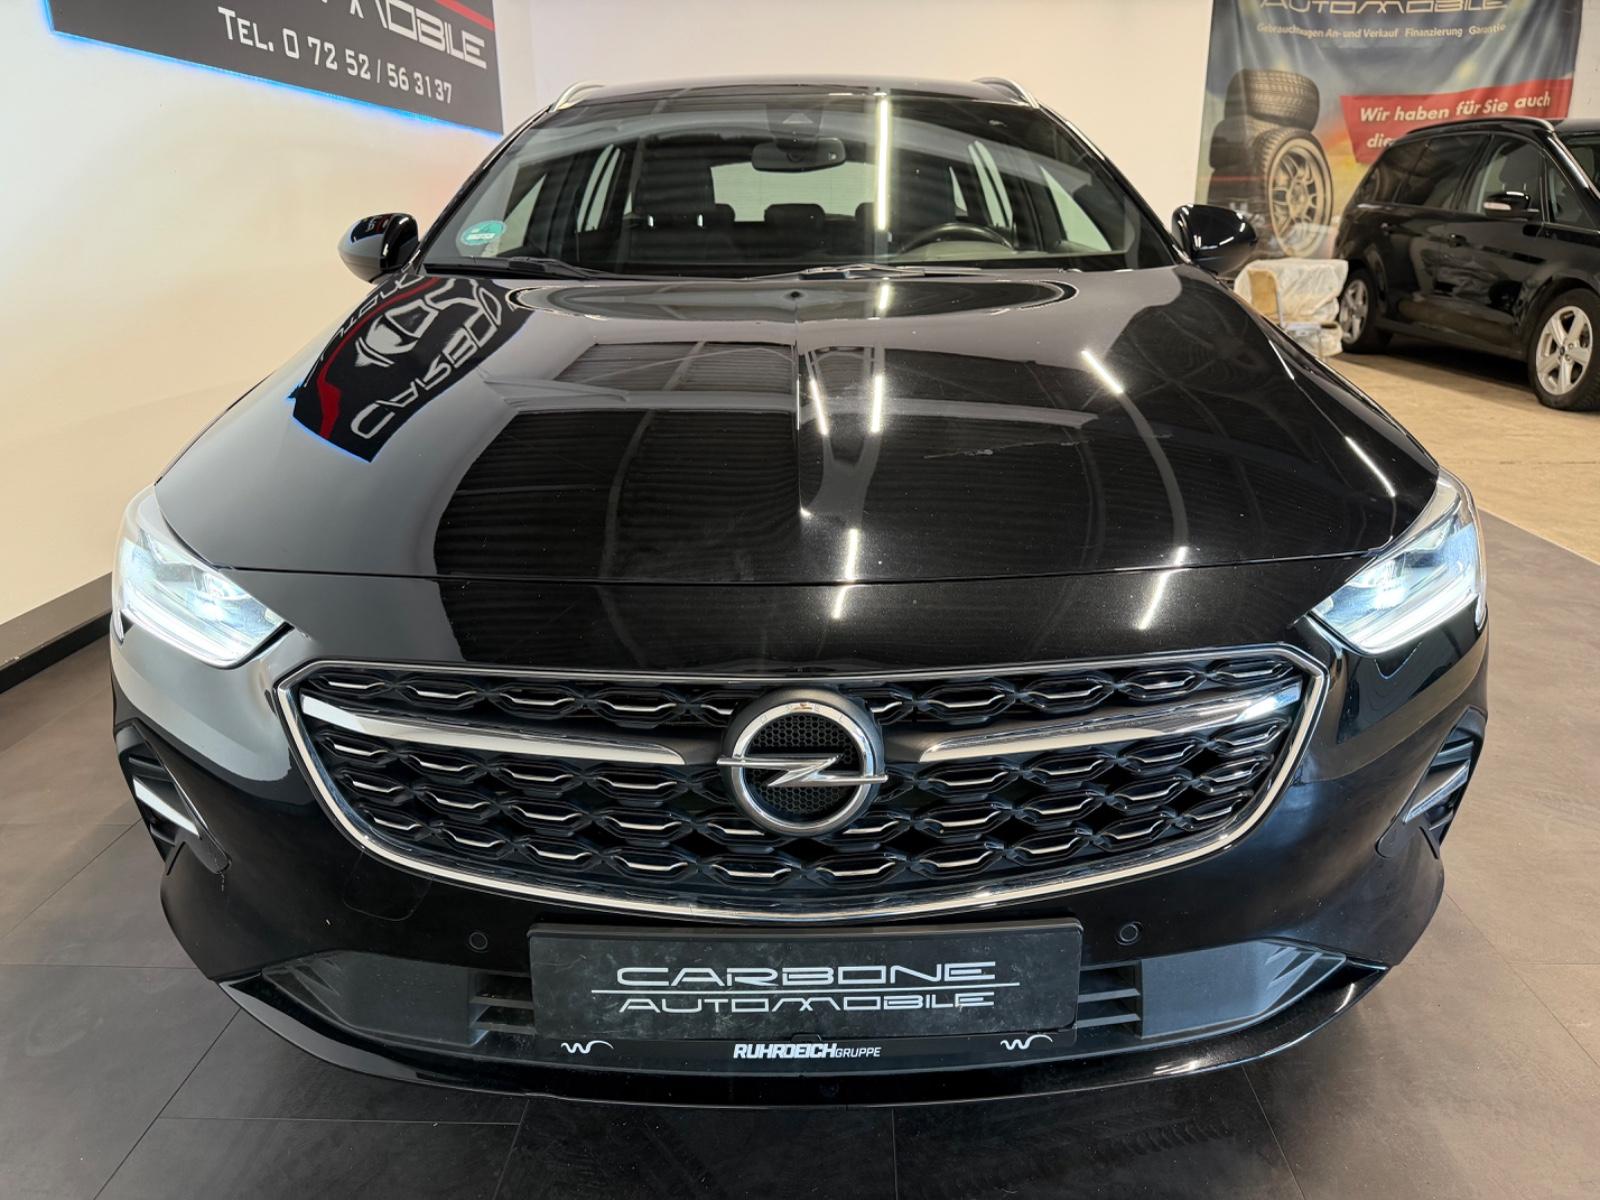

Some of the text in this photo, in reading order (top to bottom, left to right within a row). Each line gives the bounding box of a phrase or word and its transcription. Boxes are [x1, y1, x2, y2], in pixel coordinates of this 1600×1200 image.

[1363, 28, 1399, 38] Verkauf
[1405, 27, 1463, 38] Finanzierung
[1468, 23, 1506, 35] Garantie
[217, 6, 274, 52] TEL.
[307, 36, 338, 70] 72
[345, 48, 371, 80] 52
[387, 62, 409, 91] 56
[1360, 91, 1551, 122] Wir haben für Sie auch
[616, 961, 996, 987] CARBONE
[618, 991, 995, 1013] AUTOMOBILE
